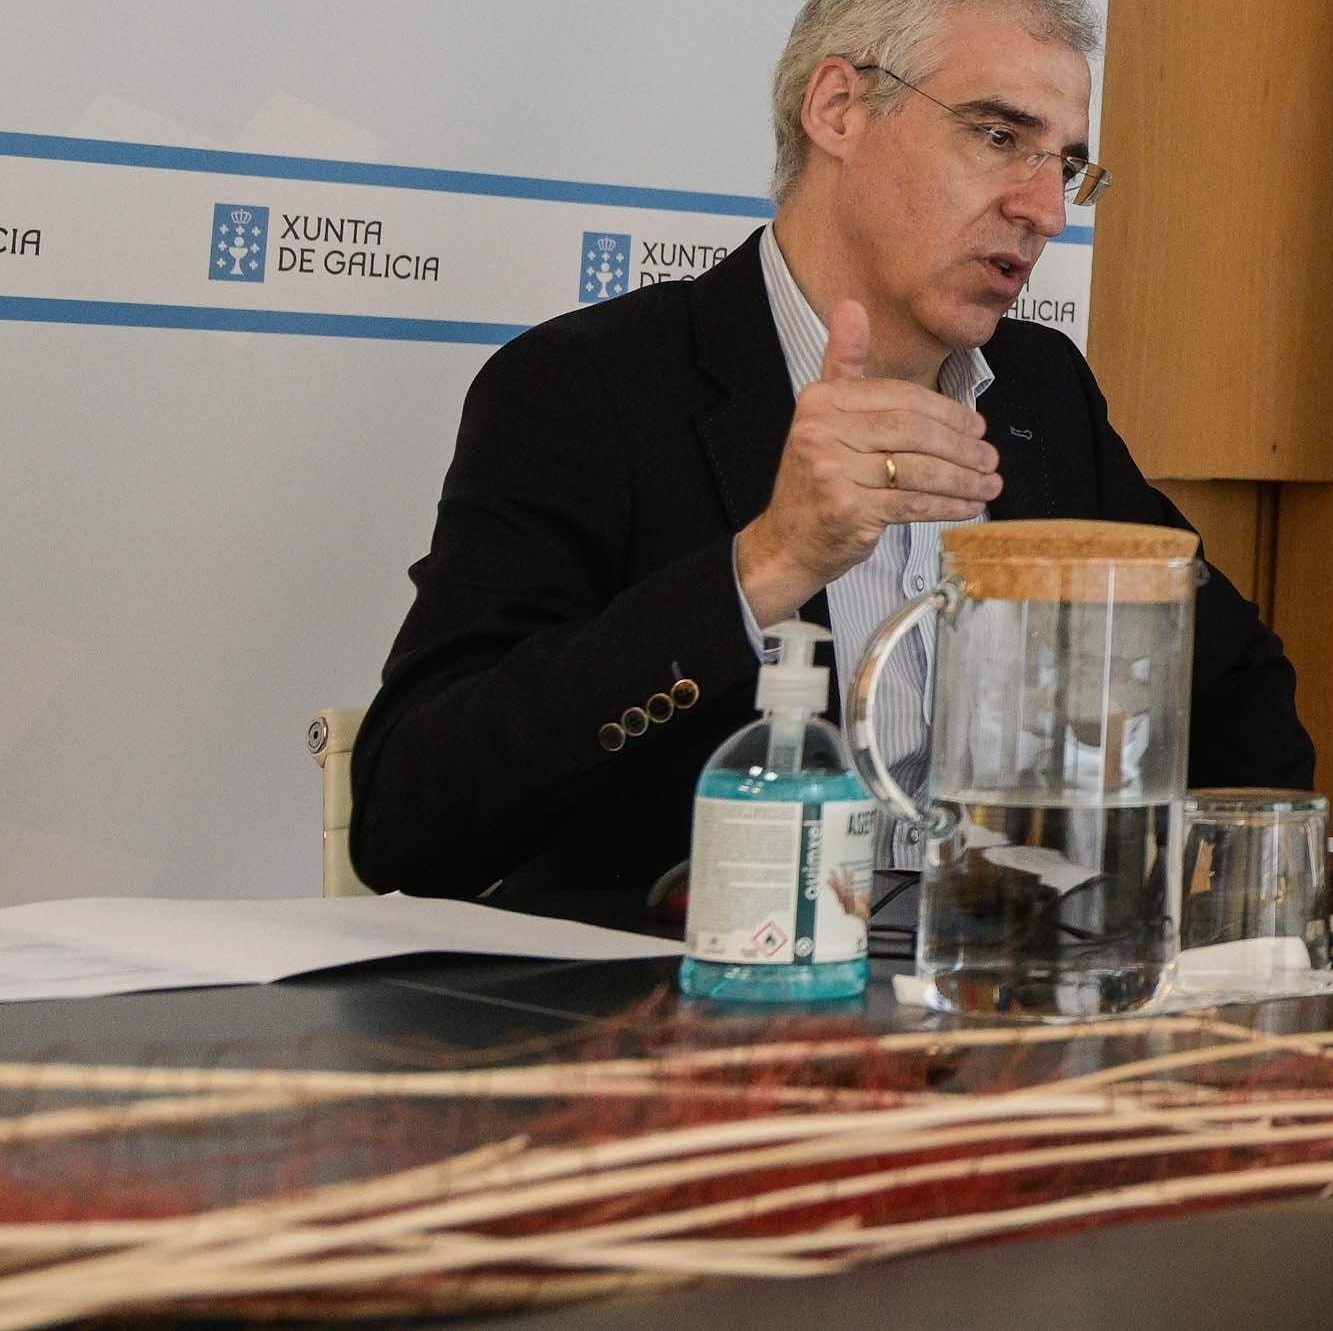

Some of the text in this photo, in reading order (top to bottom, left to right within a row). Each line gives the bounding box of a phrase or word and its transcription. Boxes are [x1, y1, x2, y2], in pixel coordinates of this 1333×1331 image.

[280, 214, 383, 246] XUNTA
[277, 247, 441, 282] DE GALICIA
[640, 241, 728, 270] XUNTA
